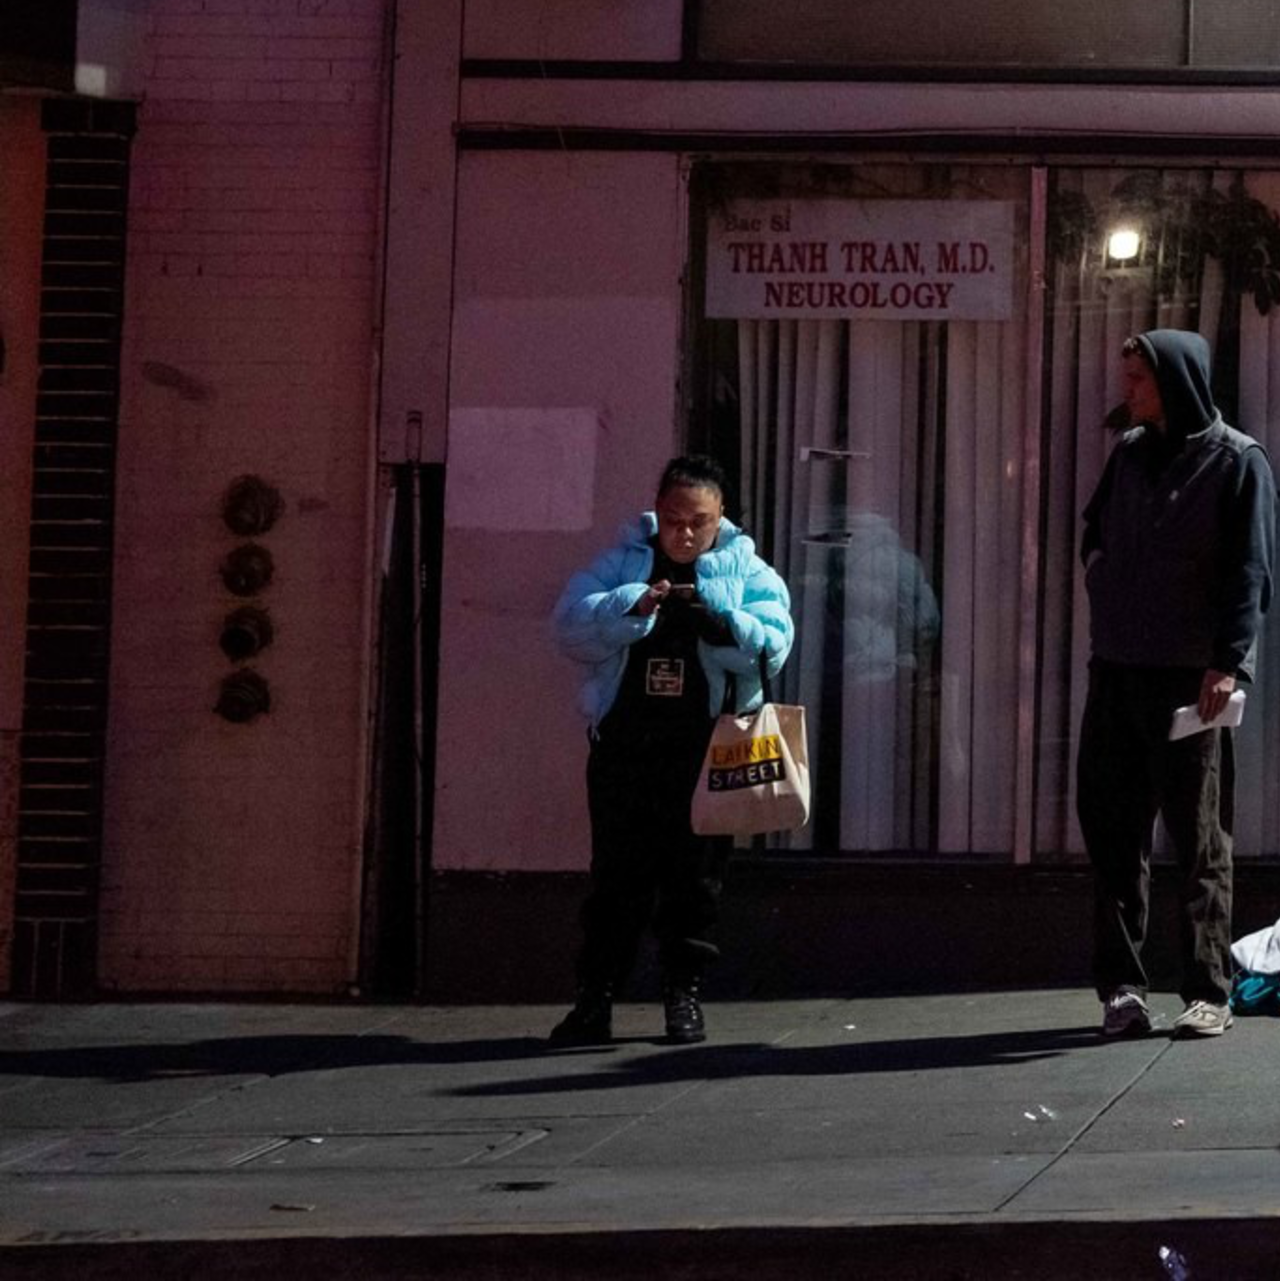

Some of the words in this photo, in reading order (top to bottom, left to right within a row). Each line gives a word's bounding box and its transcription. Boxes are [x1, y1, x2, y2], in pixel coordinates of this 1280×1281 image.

[728, 241, 828, 274] THANH
[840, 241, 926, 277] TRAN,
[936, 242, 996, 274] M.D.
[763, 281, 955, 310] NEUROLOGY
[711, 761, 781, 789] STREET
